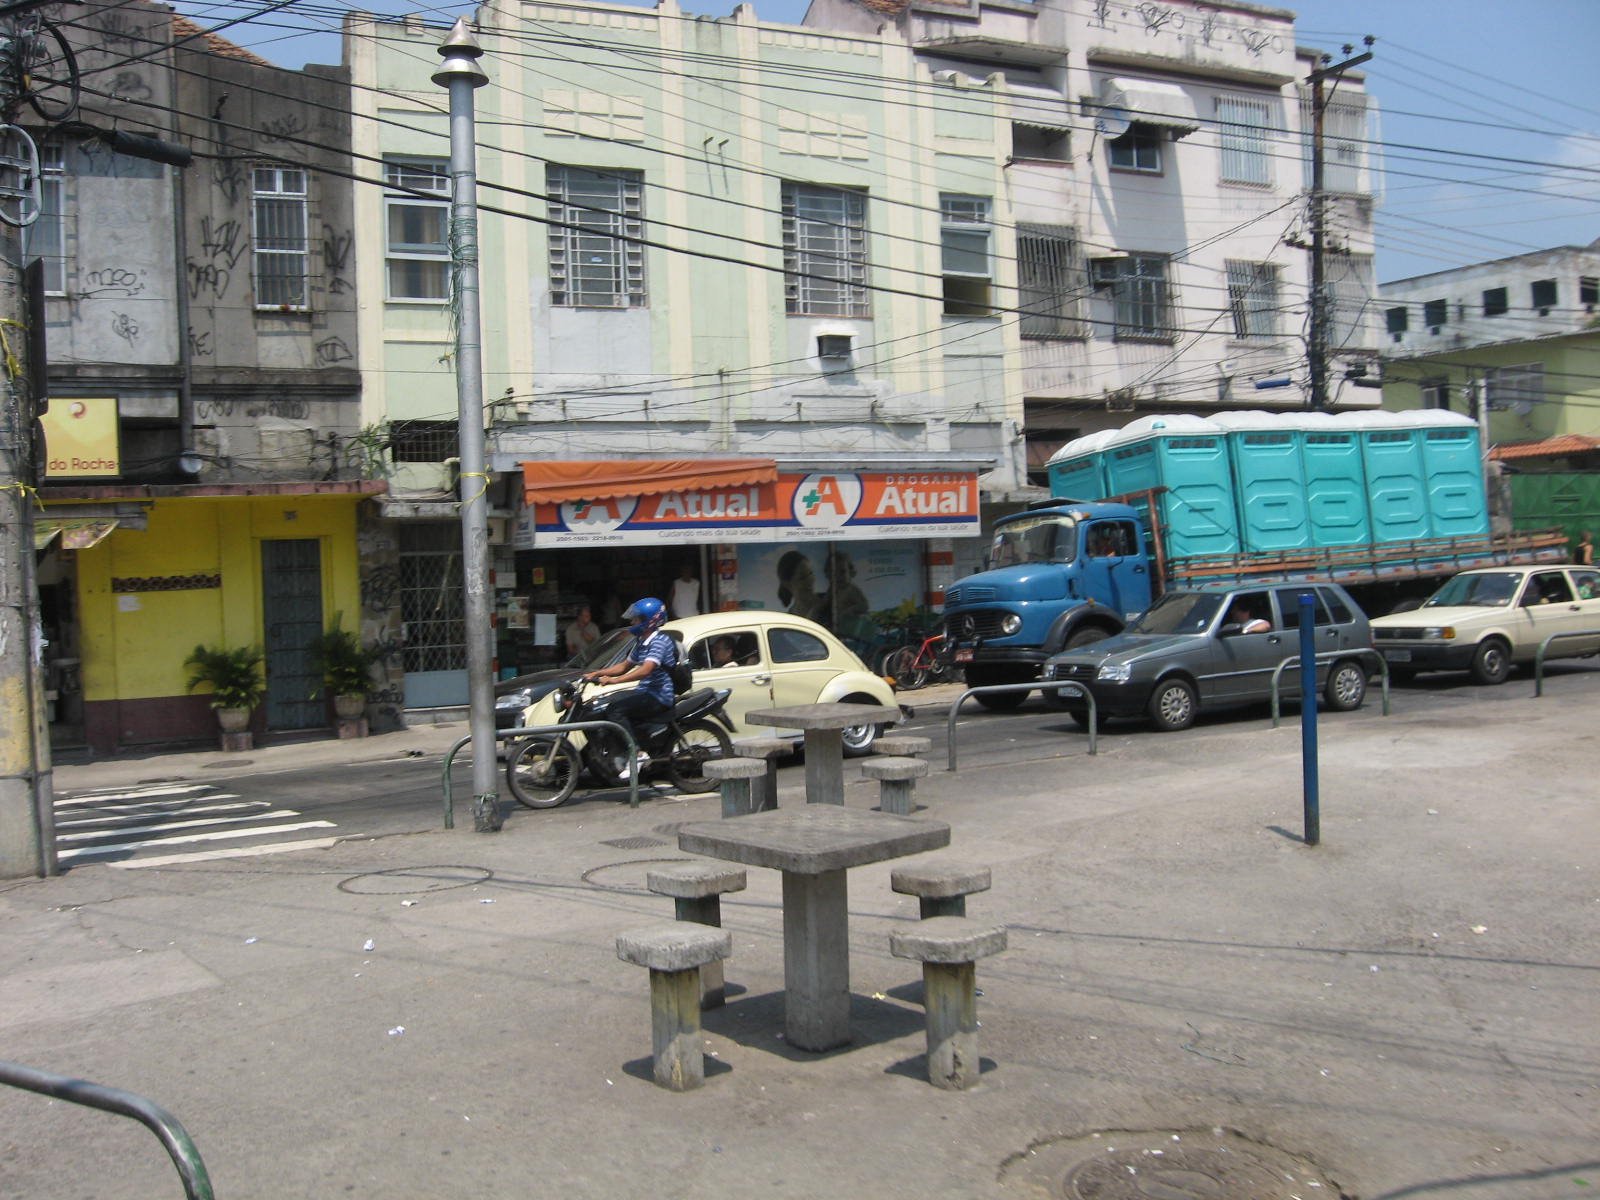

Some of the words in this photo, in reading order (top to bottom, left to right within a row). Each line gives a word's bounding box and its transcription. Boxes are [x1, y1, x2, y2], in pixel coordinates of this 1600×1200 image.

[49, 458, 67, 470] do
[71, 457, 115, 470] Rocha
[885, 475, 969, 485] DROGARIA
[653, 487, 760, 519] Atual
[875, 485, 968, 515] Atual
